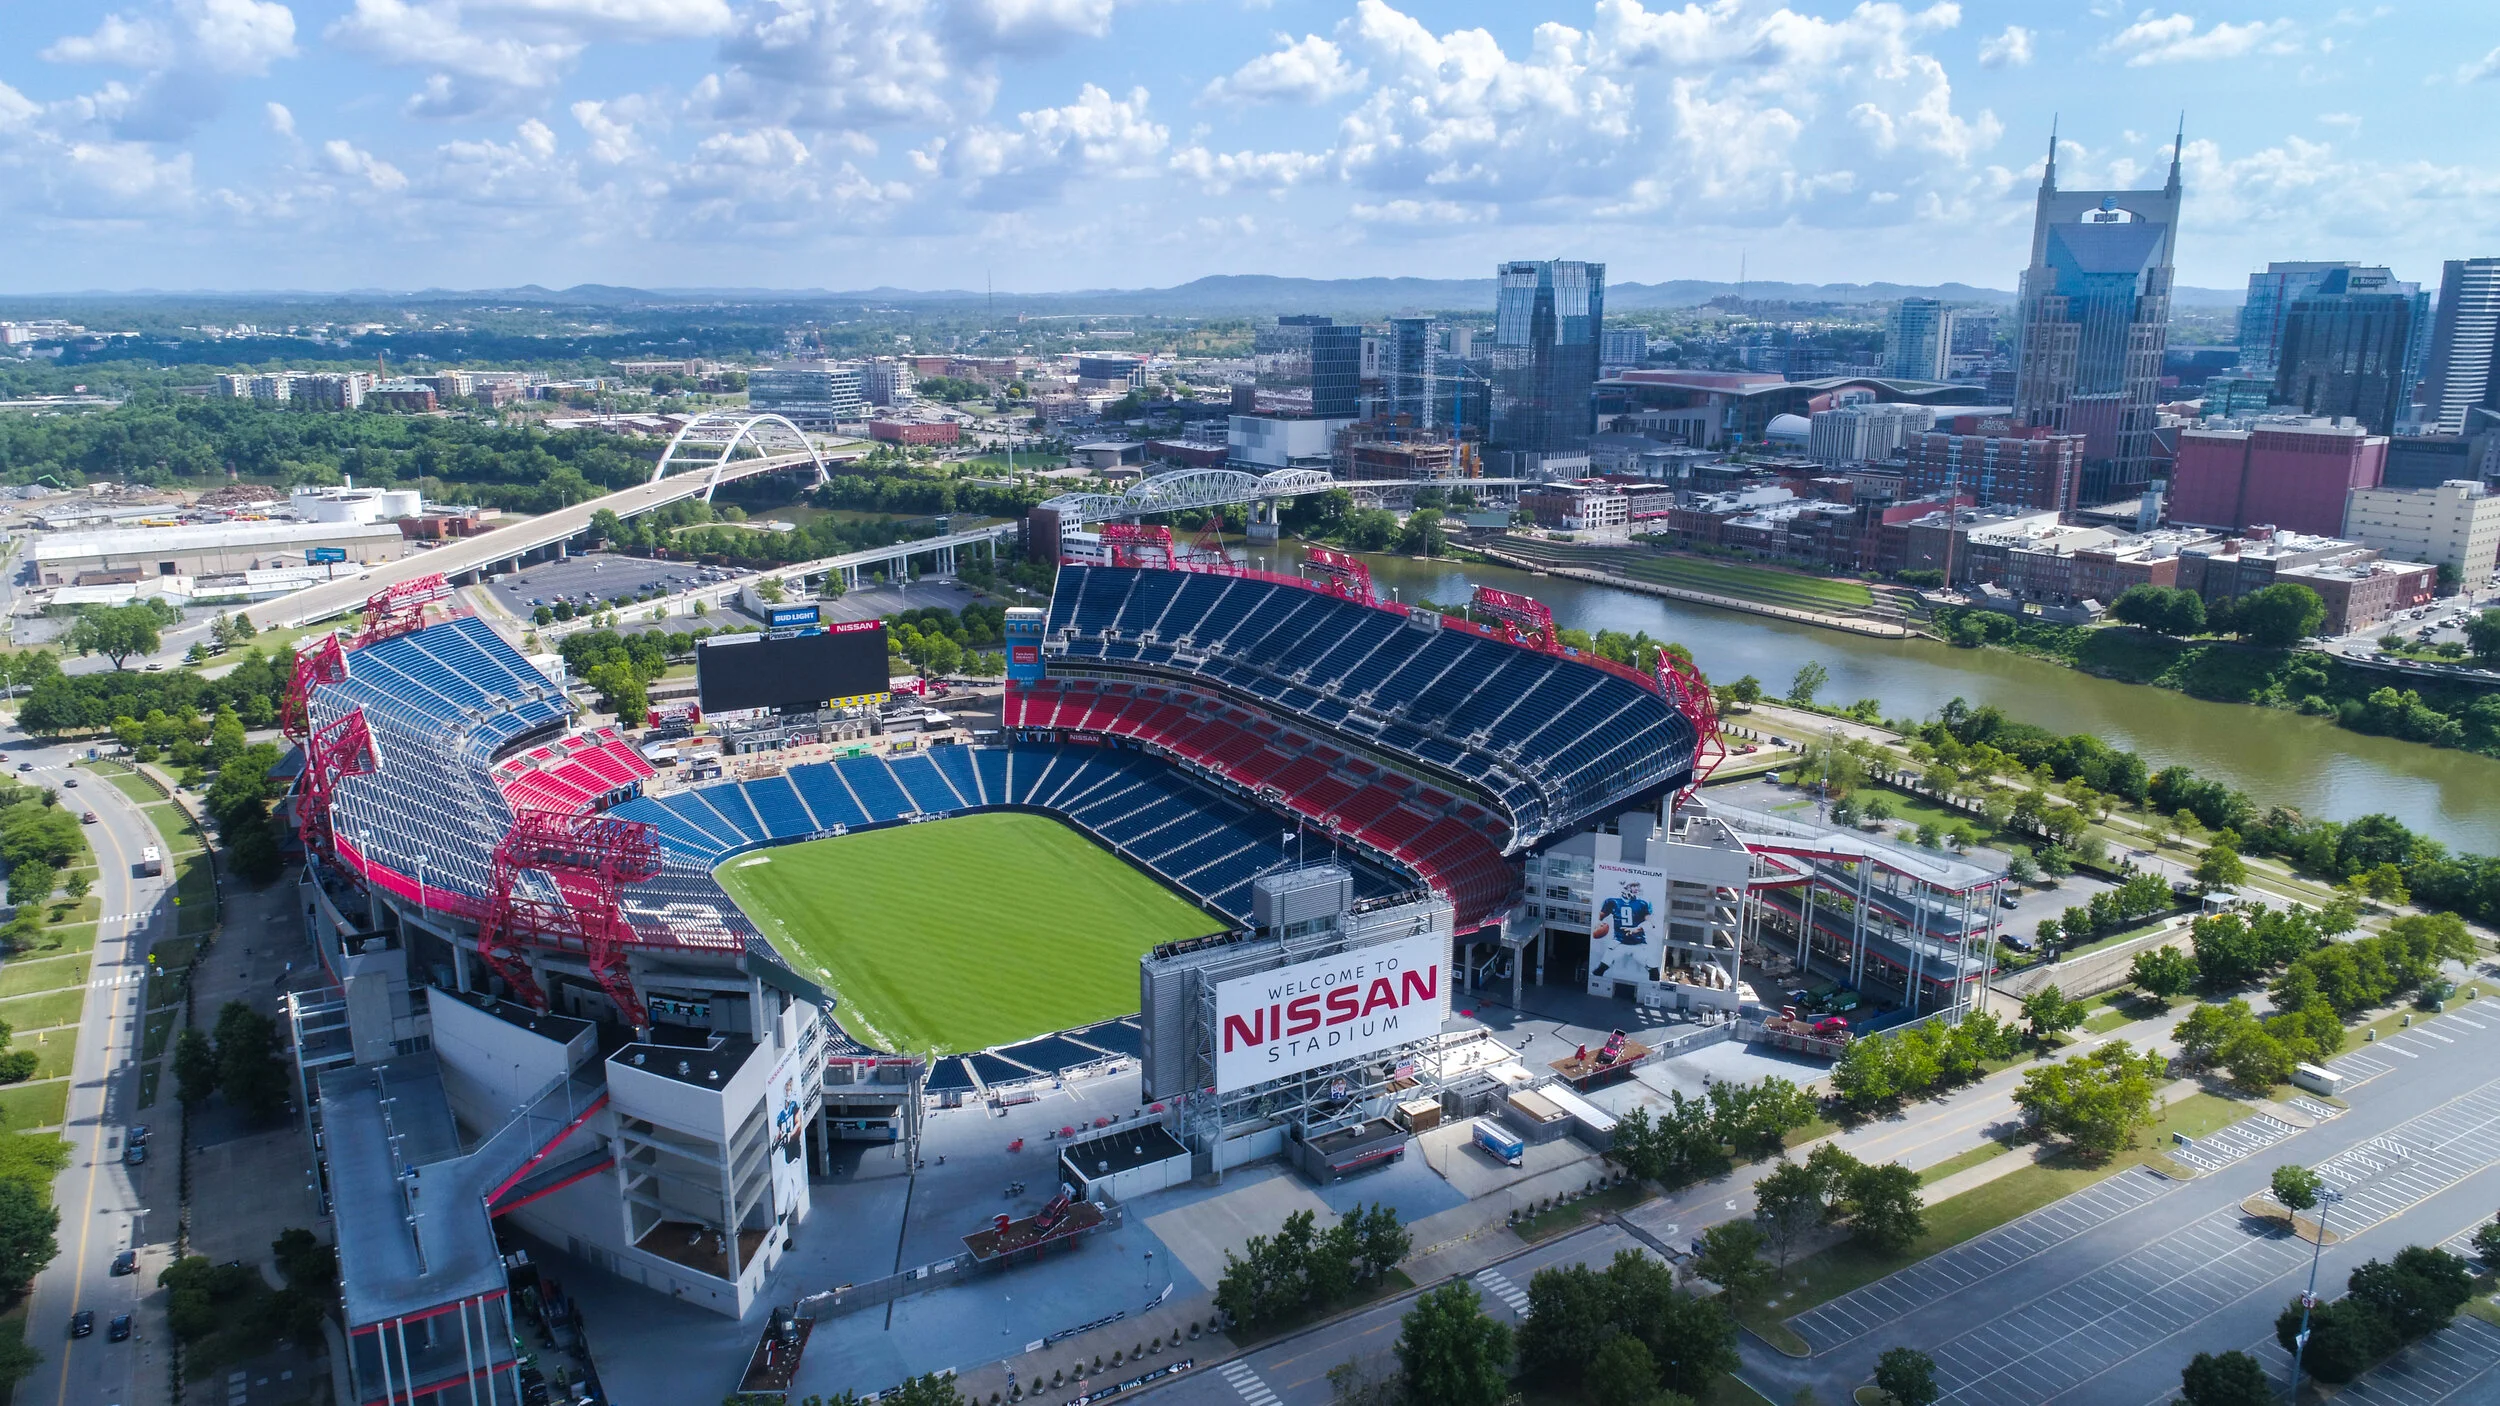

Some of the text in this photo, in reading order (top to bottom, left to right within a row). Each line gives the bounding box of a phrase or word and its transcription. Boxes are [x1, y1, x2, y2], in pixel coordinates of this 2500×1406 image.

[792, 612, 815, 621] LIGHT
[836, 622, 873, 633] NISSAN
[889, 681, 920, 690] NISSAN
[1069, 734, 1100, 743] NISSAN
[1620, 906, 1633, 927] 9
[1268, 957, 1399, 1000] WELCOME TO
[1224, 965, 1437, 1053] NISSAN
[1781, 1004, 1797, 1022] 5
[1268, 1015, 1398, 1063] STADIUM
[1398, 1061, 1411, 1069] CMA
[992, 1213, 1011, 1237] 3
